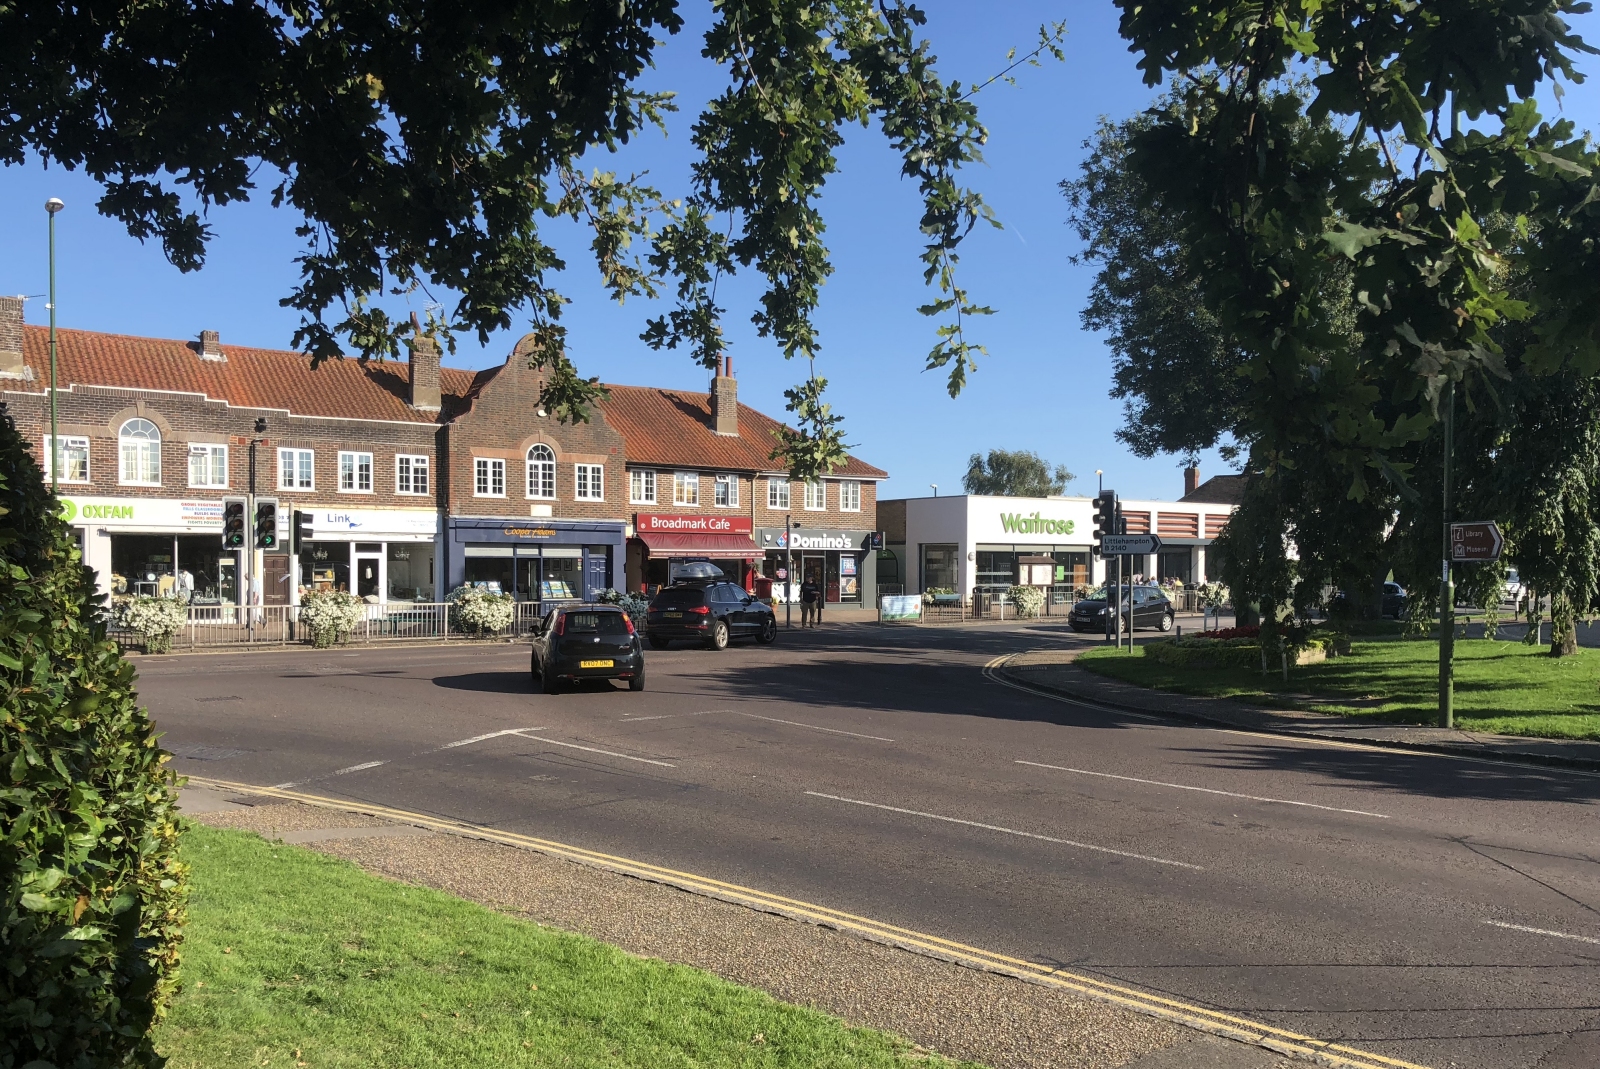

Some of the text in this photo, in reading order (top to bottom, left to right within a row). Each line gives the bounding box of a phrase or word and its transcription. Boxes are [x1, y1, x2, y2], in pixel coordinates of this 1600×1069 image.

[83, 505, 134, 519] OXFAM
[327, 513, 351, 523] Link
[651, 516, 731, 530] Broadmark Cafe
[1000, 511, 1074, 535] Waitrose
[790, 533, 852, 548] Domino's
